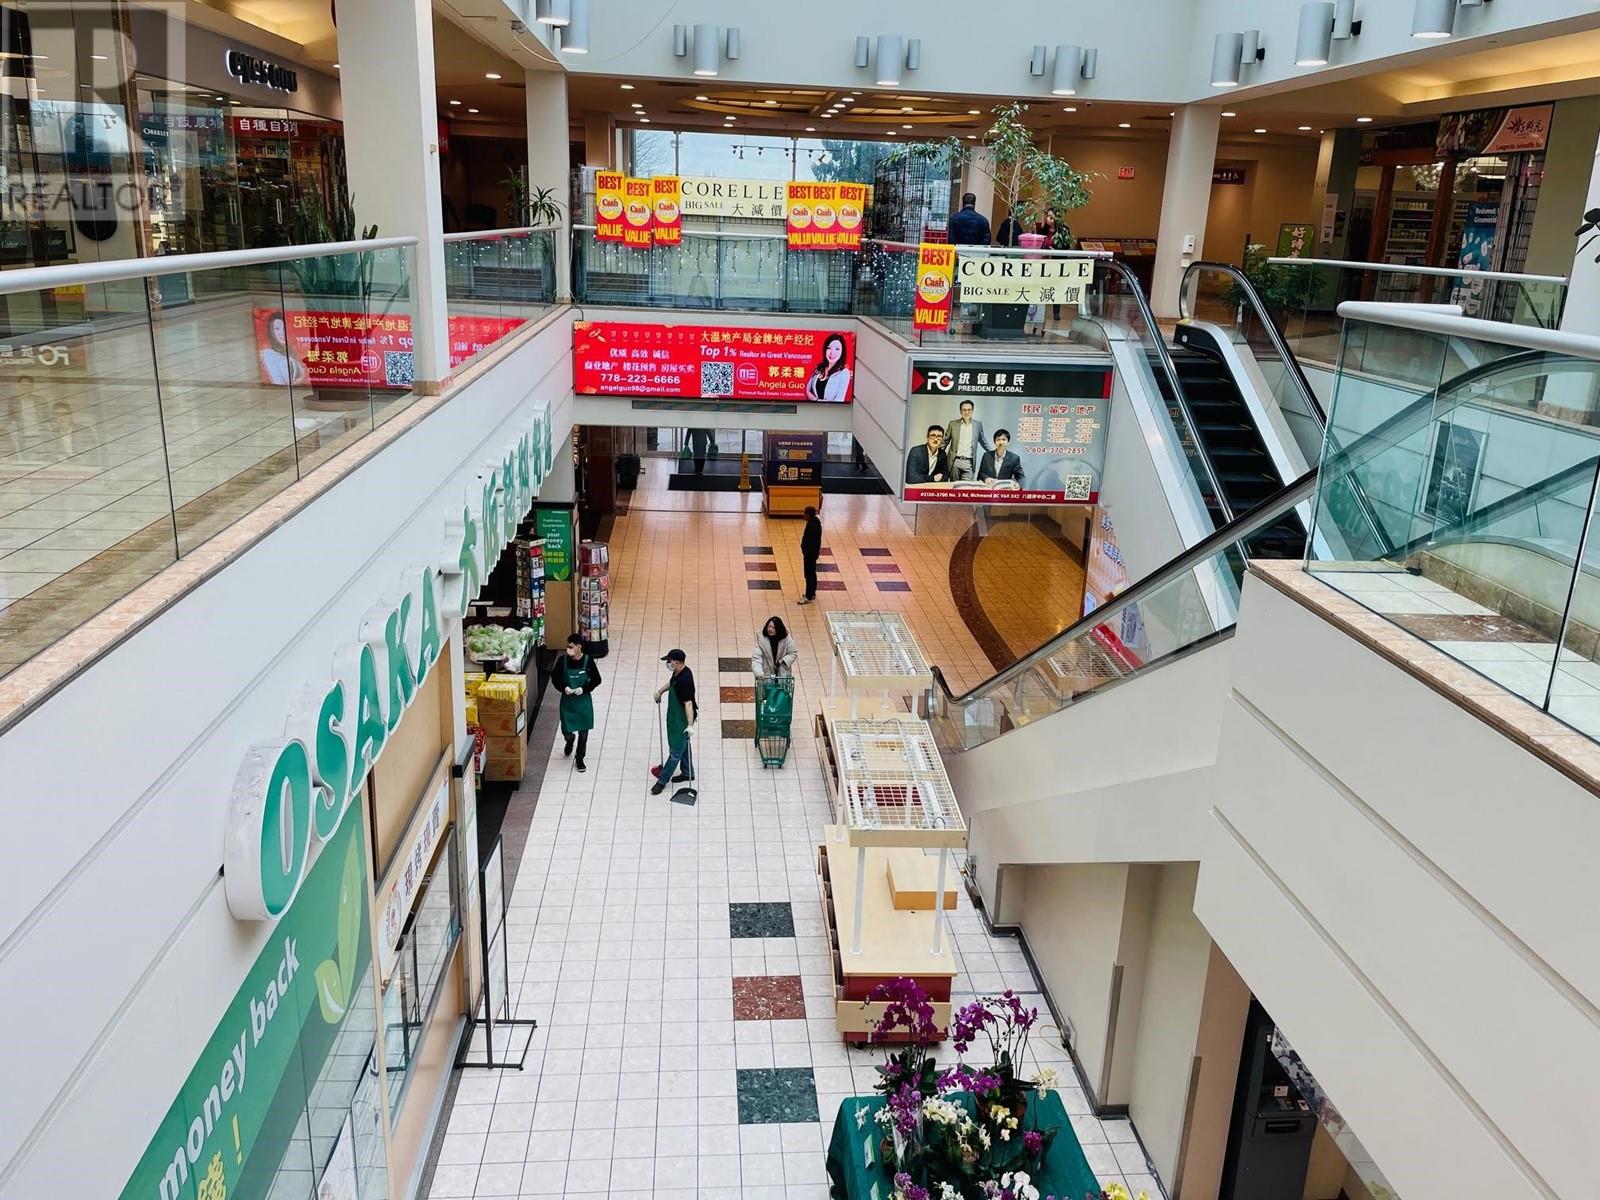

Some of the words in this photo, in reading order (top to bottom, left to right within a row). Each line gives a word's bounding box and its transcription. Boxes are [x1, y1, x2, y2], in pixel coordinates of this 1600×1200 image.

[598, 176, 622, 190] BEST
[627, 182, 651, 197] BEST
[654, 180, 678, 194] BEST
[681, 181, 784, 200] CORELLE
[789, 185, 812, 199] BEST
[814, 186, 837, 200] BEST
[841, 186, 863, 200] BEST
[630, 205, 646, 213] Cash
[685, 201, 702, 210] BIG
[793, 208, 808, 216] Cash
[816, 208, 832, 216] Cash
[842, 208, 857, 217] Cash
[597, 223, 623, 236] VALUE
[655, 227, 680, 240] VALUE
[625, 230, 651, 243] VALUE
[812, 233, 837, 245] VALUE
[837, 233, 860, 245] VALUE
[921, 249, 952, 267] BEST
[962, 261, 1089, 278] CORELLE
[925, 277, 944, 287] Cash
[963, 286, 983, 296] BIG
[986, 287, 1009, 296] SALE
[915, 308, 948, 326] VALUE
[700, 345, 720, 358] Top
[723, 346, 737, 357] 1%
[739, 350, 759, 358] Realtor
[760, 350, 766, 358] in
[767, 351, 783, 359] Great
[784, 352, 812, 360] Vancouver
[600, 373, 680, 384] 778-223-6666
[758, 380, 787, 390] Angela
[788, 381, 805, 389] Guo
[245, 564, 442, 918] OSAKA
[158, 1030, 248, 1200] money
[249, 936, 300, 1048] back
